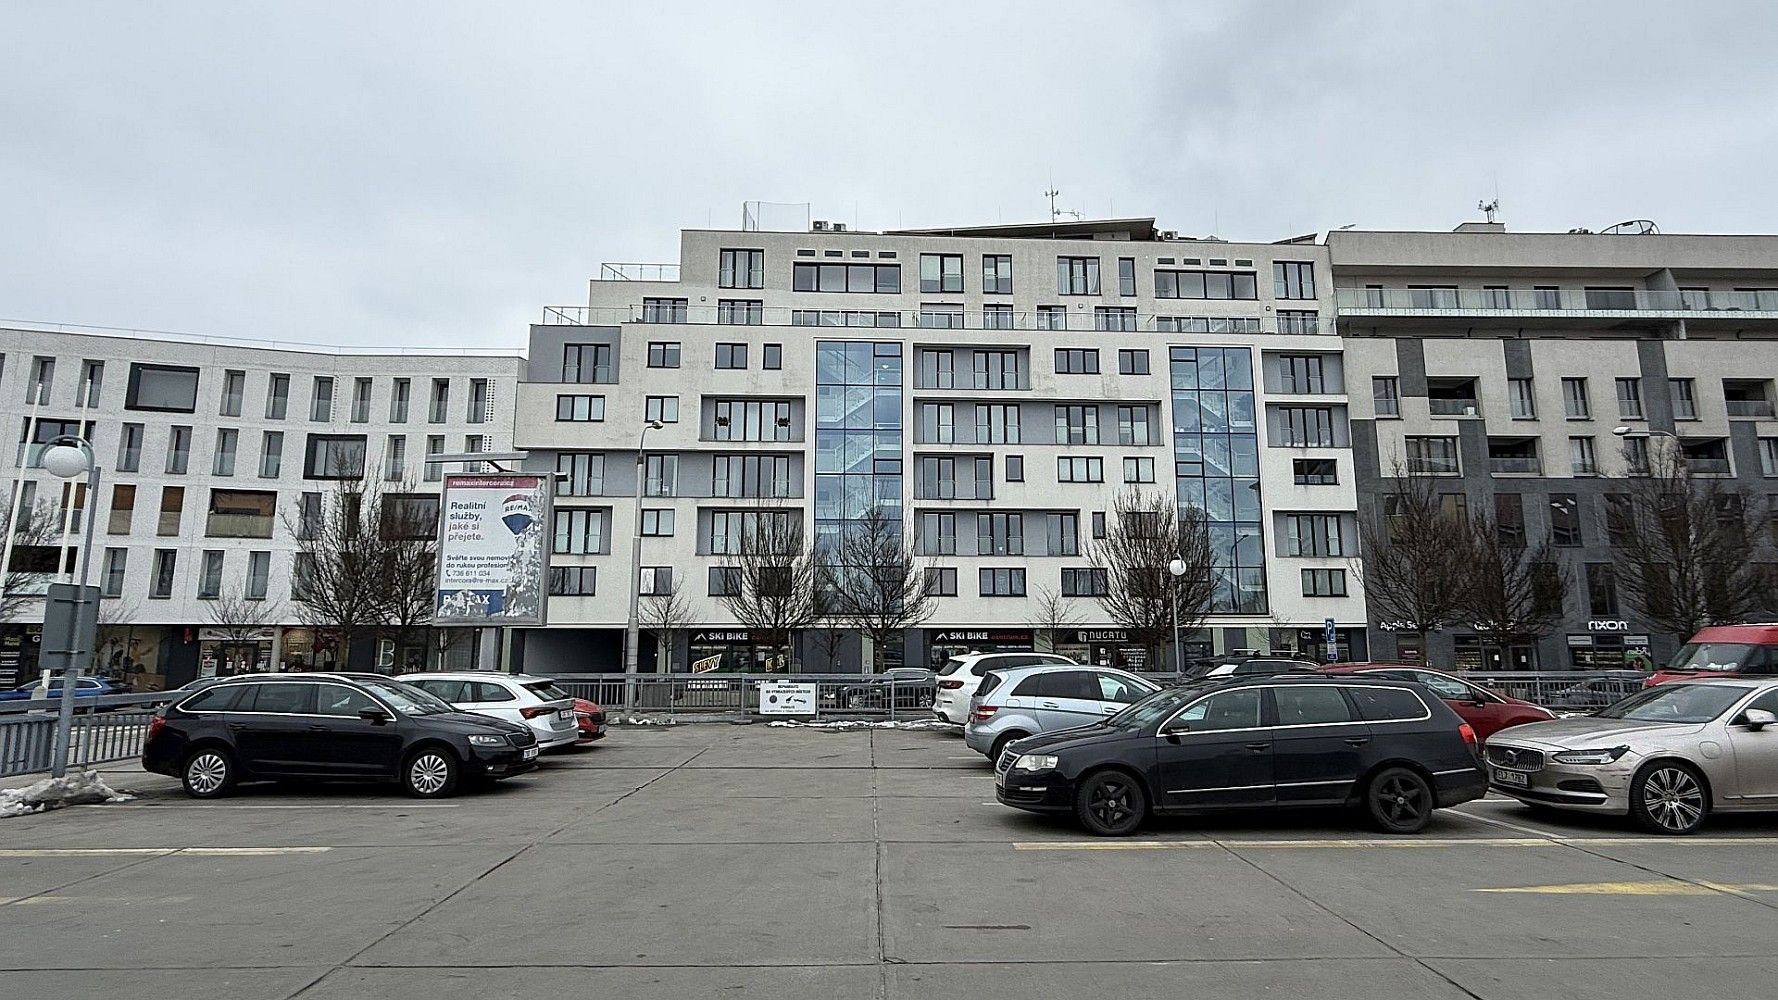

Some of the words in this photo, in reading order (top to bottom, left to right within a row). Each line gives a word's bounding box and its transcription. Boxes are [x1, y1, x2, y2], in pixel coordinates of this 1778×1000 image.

[450, 501, 487, 510] Realitní
[449, 511, 482, 522] služby,
[448, 522, 469, 532] jaké
[471, 522, 480, 530] si
[448, 532, 484, 542] přejete.
[1326, 621, 1333, 635] P
[694, 656, 719, 673] SLEVY
